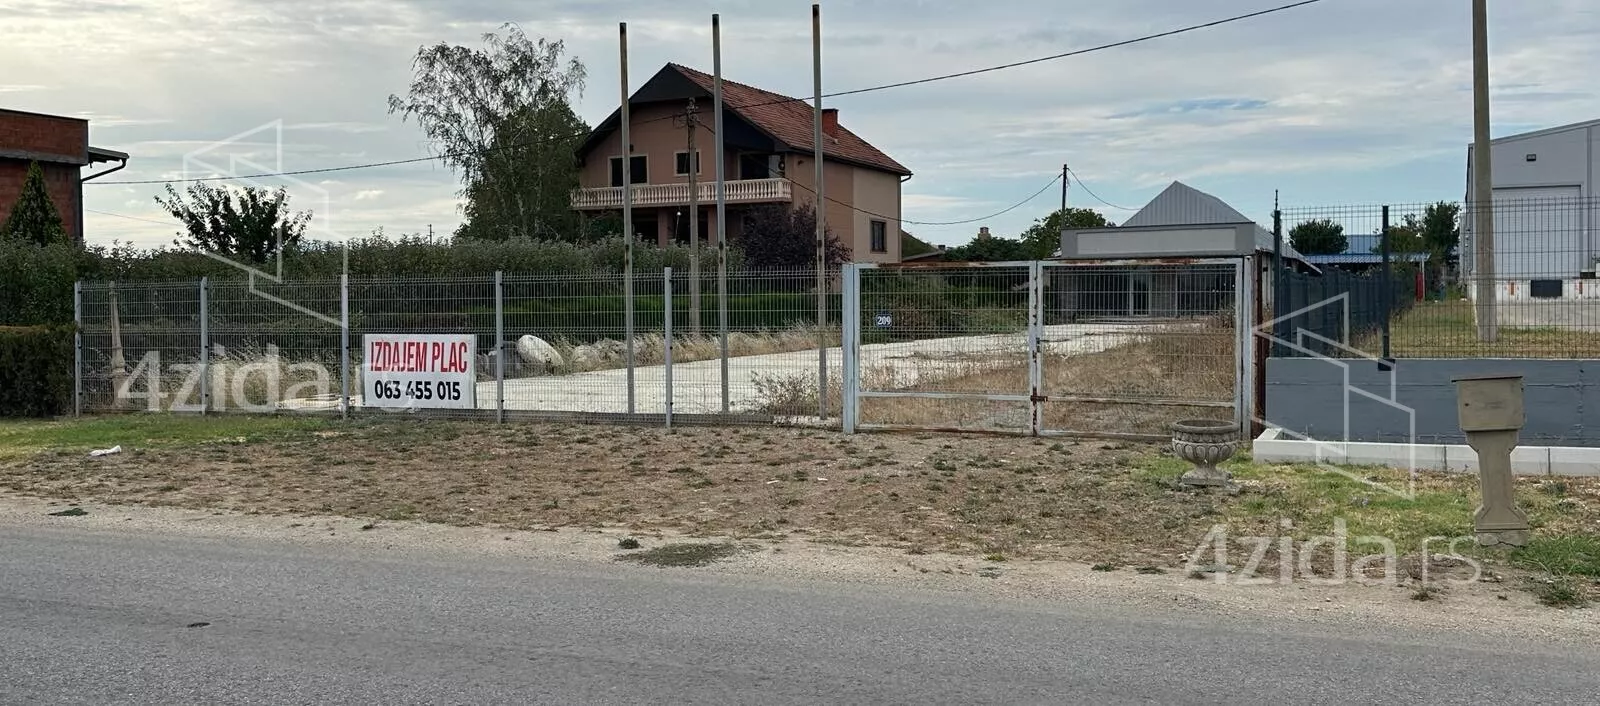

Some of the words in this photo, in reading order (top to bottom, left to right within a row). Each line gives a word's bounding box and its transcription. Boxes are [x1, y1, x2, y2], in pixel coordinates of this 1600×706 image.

[877, 316, 891, 325] 209
[370, 341, 428, 373] IZDAJEM
[431, 342, 468, 373] PLAC
[375, 380, 401, 399] 063
[405, 381, 433, 400] 455
[437, 381, 461, 401] 015
